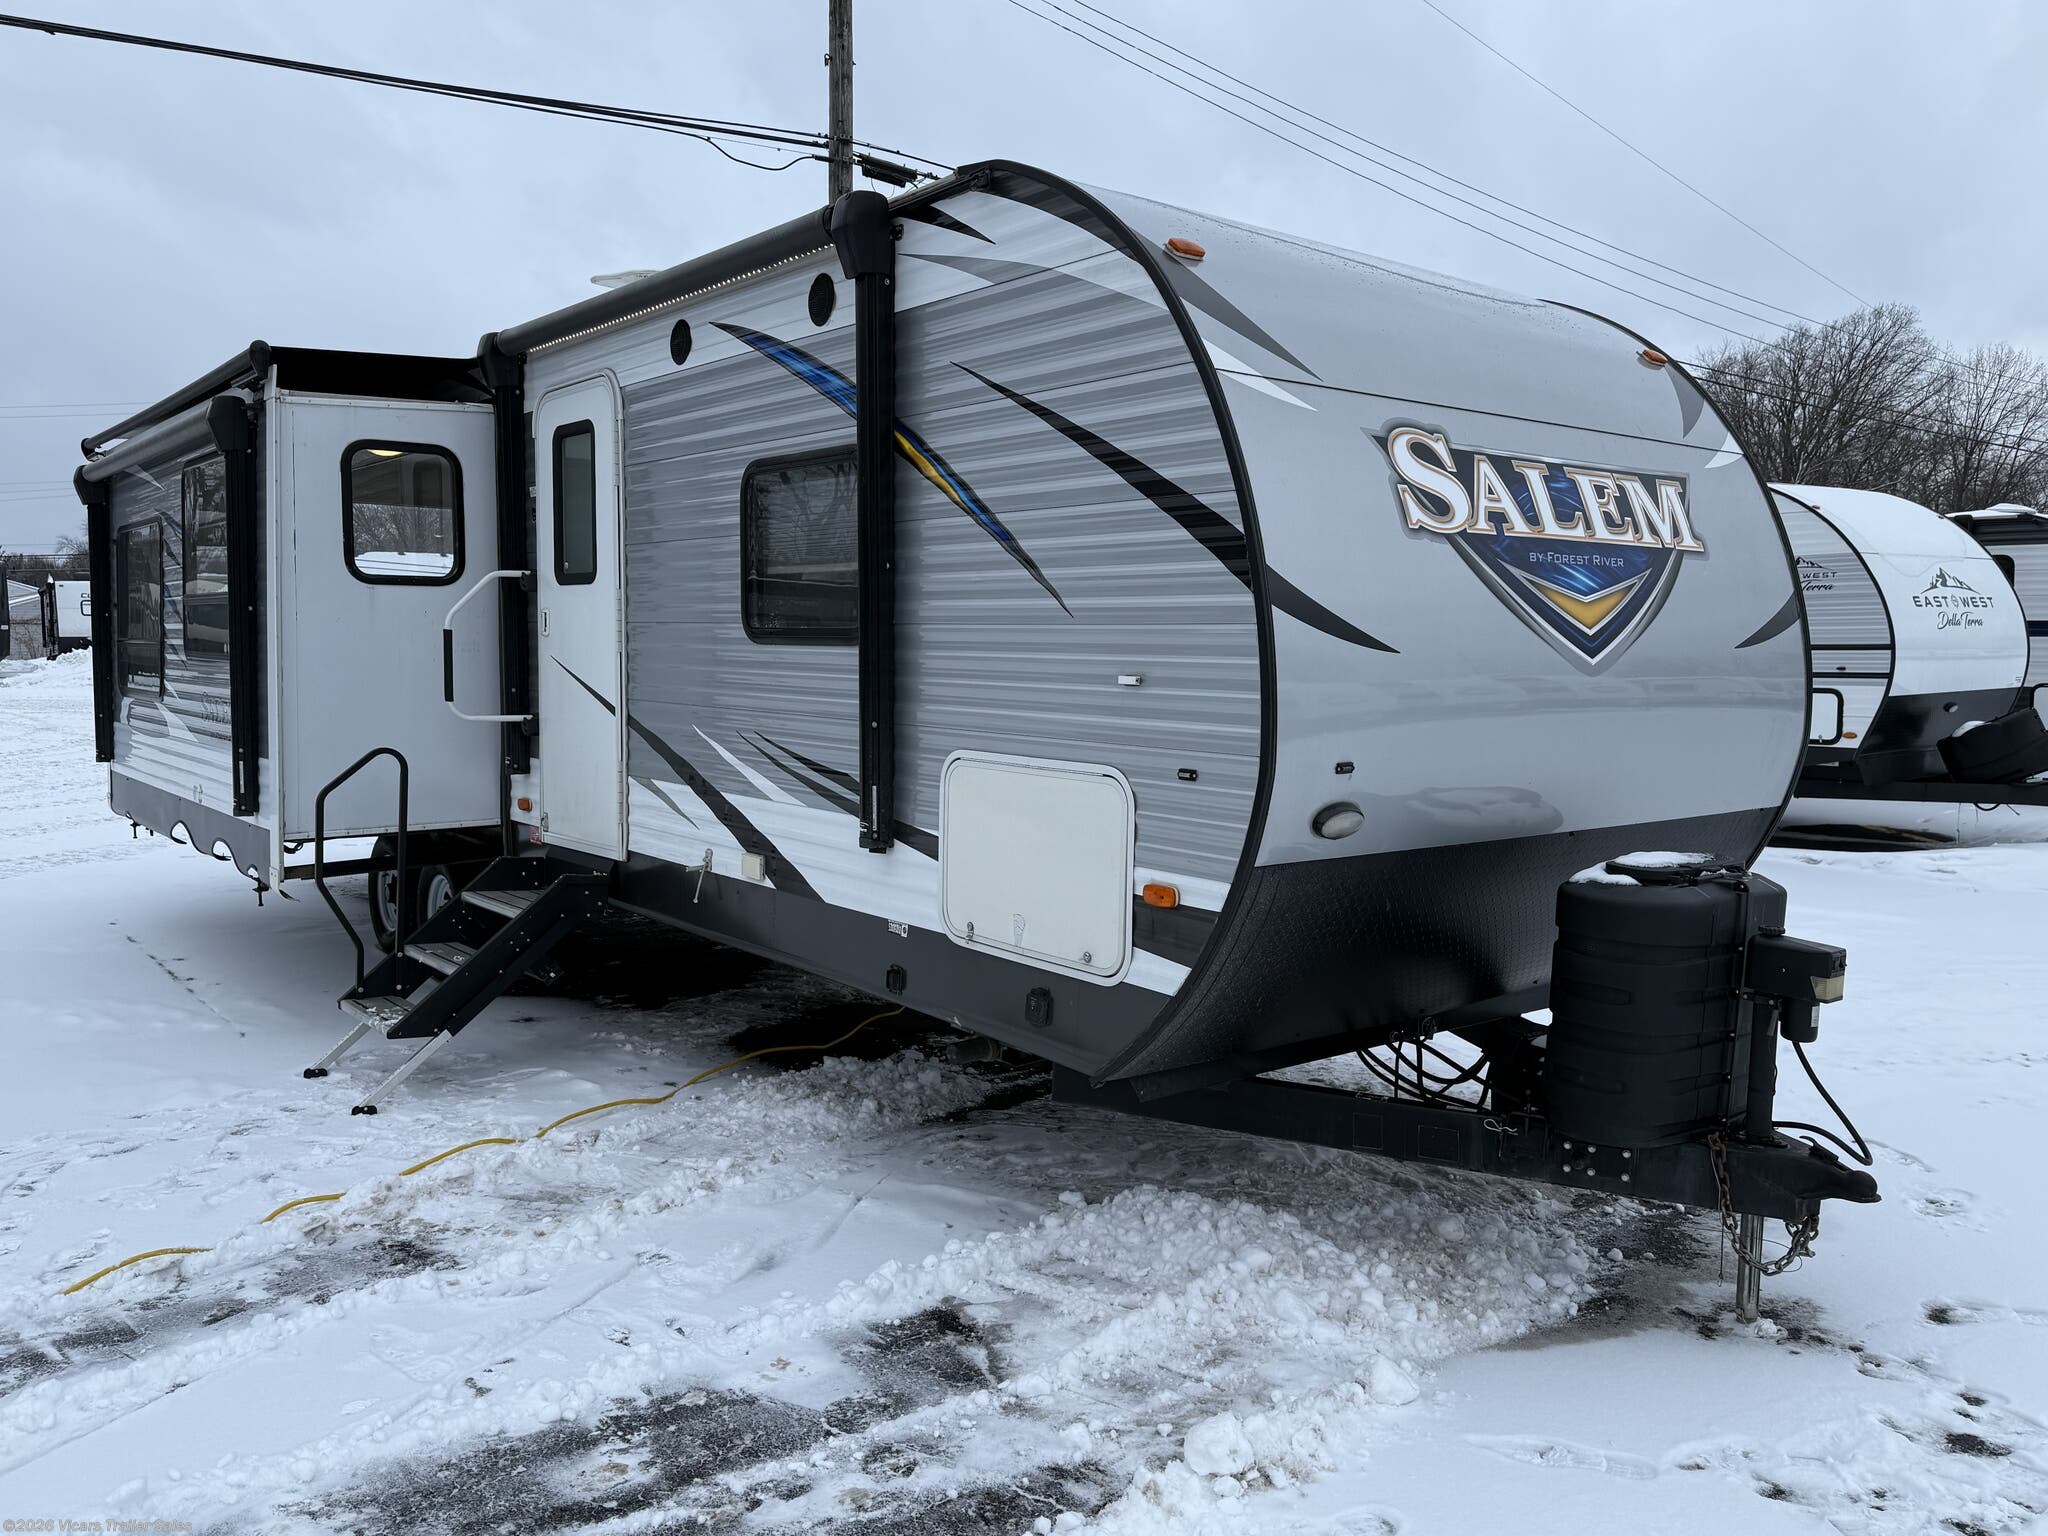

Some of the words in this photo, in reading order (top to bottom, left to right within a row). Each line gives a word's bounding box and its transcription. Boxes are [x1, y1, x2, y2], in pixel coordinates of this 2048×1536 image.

[1387, 426, 1705, 553] SALEM
[1529, 552, 1544, 562] BY
[1547, 552, 1589, 565] FOREST
[1592, 555, 1624, 568] RIVER
[1802, 571, 1838, 579] WEST
[1912, 595, 1949, 608] EAST
[1959, 596, 1994, 608] WEST
[1937, 611, 1961, 630] Della
[1960, 611, 1983, 630] Terra
